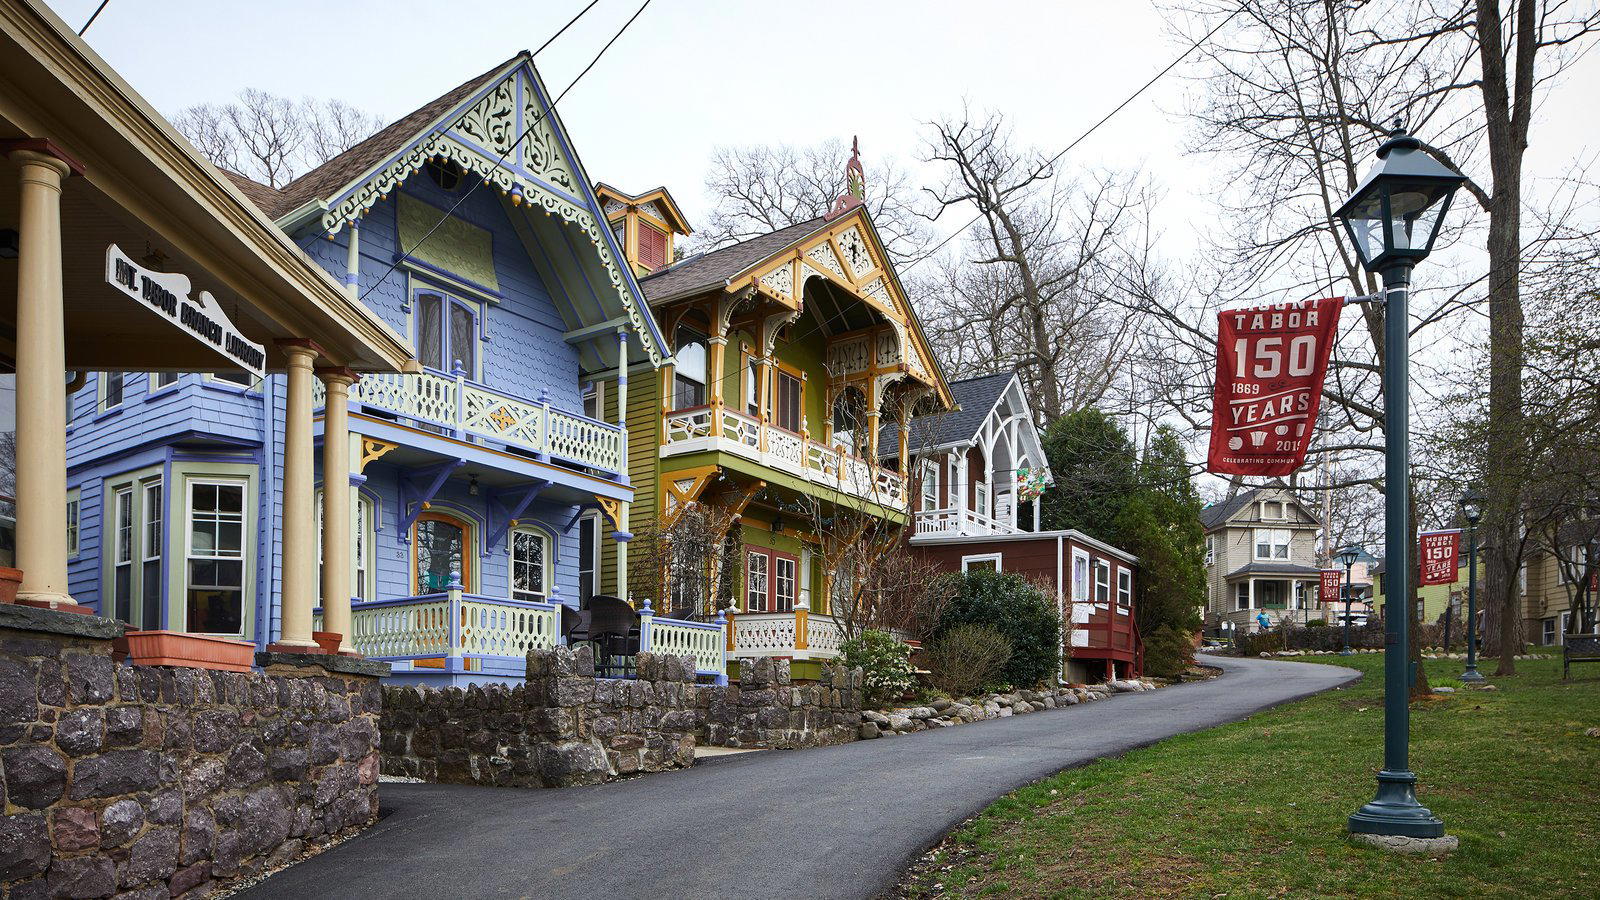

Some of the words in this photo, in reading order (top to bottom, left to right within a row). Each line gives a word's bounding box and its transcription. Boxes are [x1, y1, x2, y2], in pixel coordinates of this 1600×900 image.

[116, 258, 138, 291] MT.
[141, 275, 177, 317] TABOR
[181, 302, 222, 345] BRANCH
[1234, 311, 1319, 330] TABOR
[1234, 334, 1317, 379] 150
[1231, 382, 1260, 395] 1869
[1231, 392, 1310, 425] YEARS
[1426, 547, 1452, 559] 150
